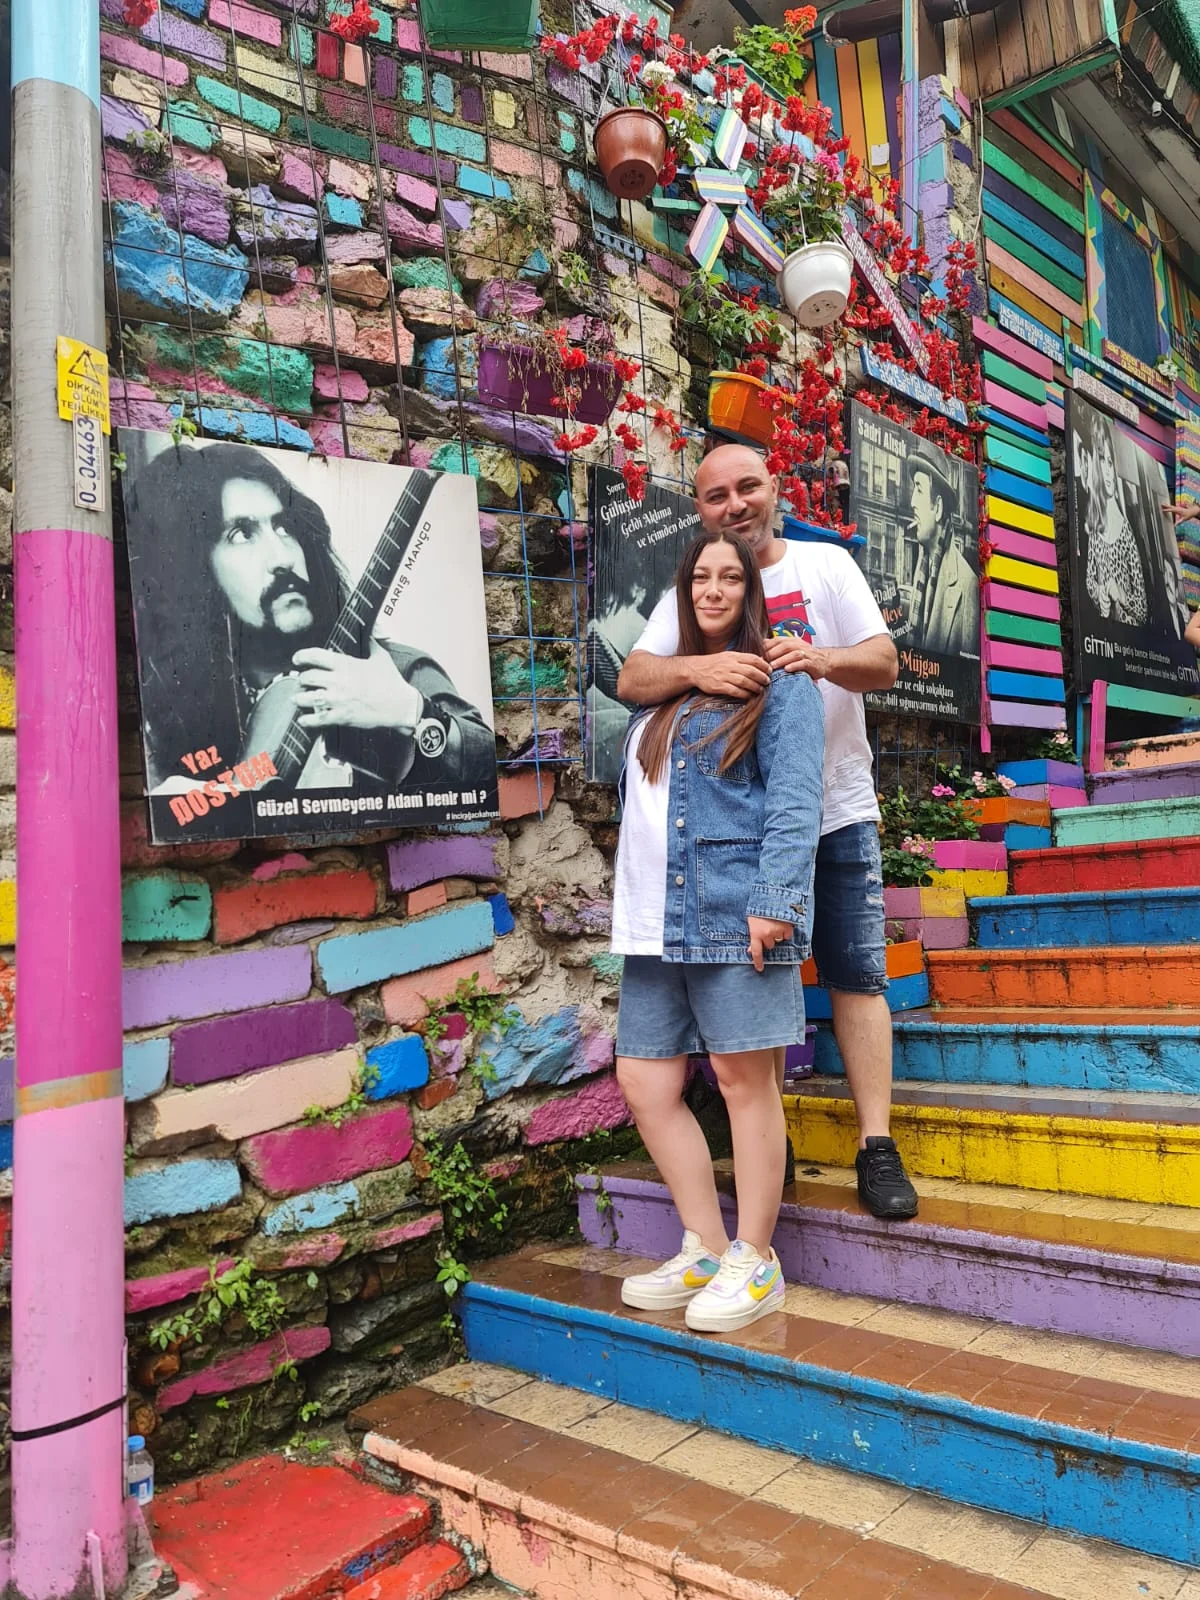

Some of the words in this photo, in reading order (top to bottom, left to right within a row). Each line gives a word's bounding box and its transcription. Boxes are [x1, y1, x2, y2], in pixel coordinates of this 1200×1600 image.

[858, 417, 882, 446] Sadri
[621, 517, 643, 539] Geldi
[643, 506, 673, 527] Aklıma
[636, 537, 647, 549] ve
[646, 525, 678, 546] içimden
[404, 521, 432, 571] MANÇO
[1084, 634, 1115, 660] GİTTİN
[899, 648, 940, 679] Müjgan
[904, 681, 912, 691] ve
[912, 680, 925, 695] eski
[926, 683, 954, 699] sokaklara
[938, 701, 959, 715] dediler
[180, 745, 222, 775] Yaz
[256, 797, 299, 817] Güzel
[302, 796, 383, 815] Sevmeyene
[387, 793, 423, 810] Adam
[426, 790, 459, 807] Denir
[461, 788, 478, 805] mi
[480, 789, 487, 804] ?
